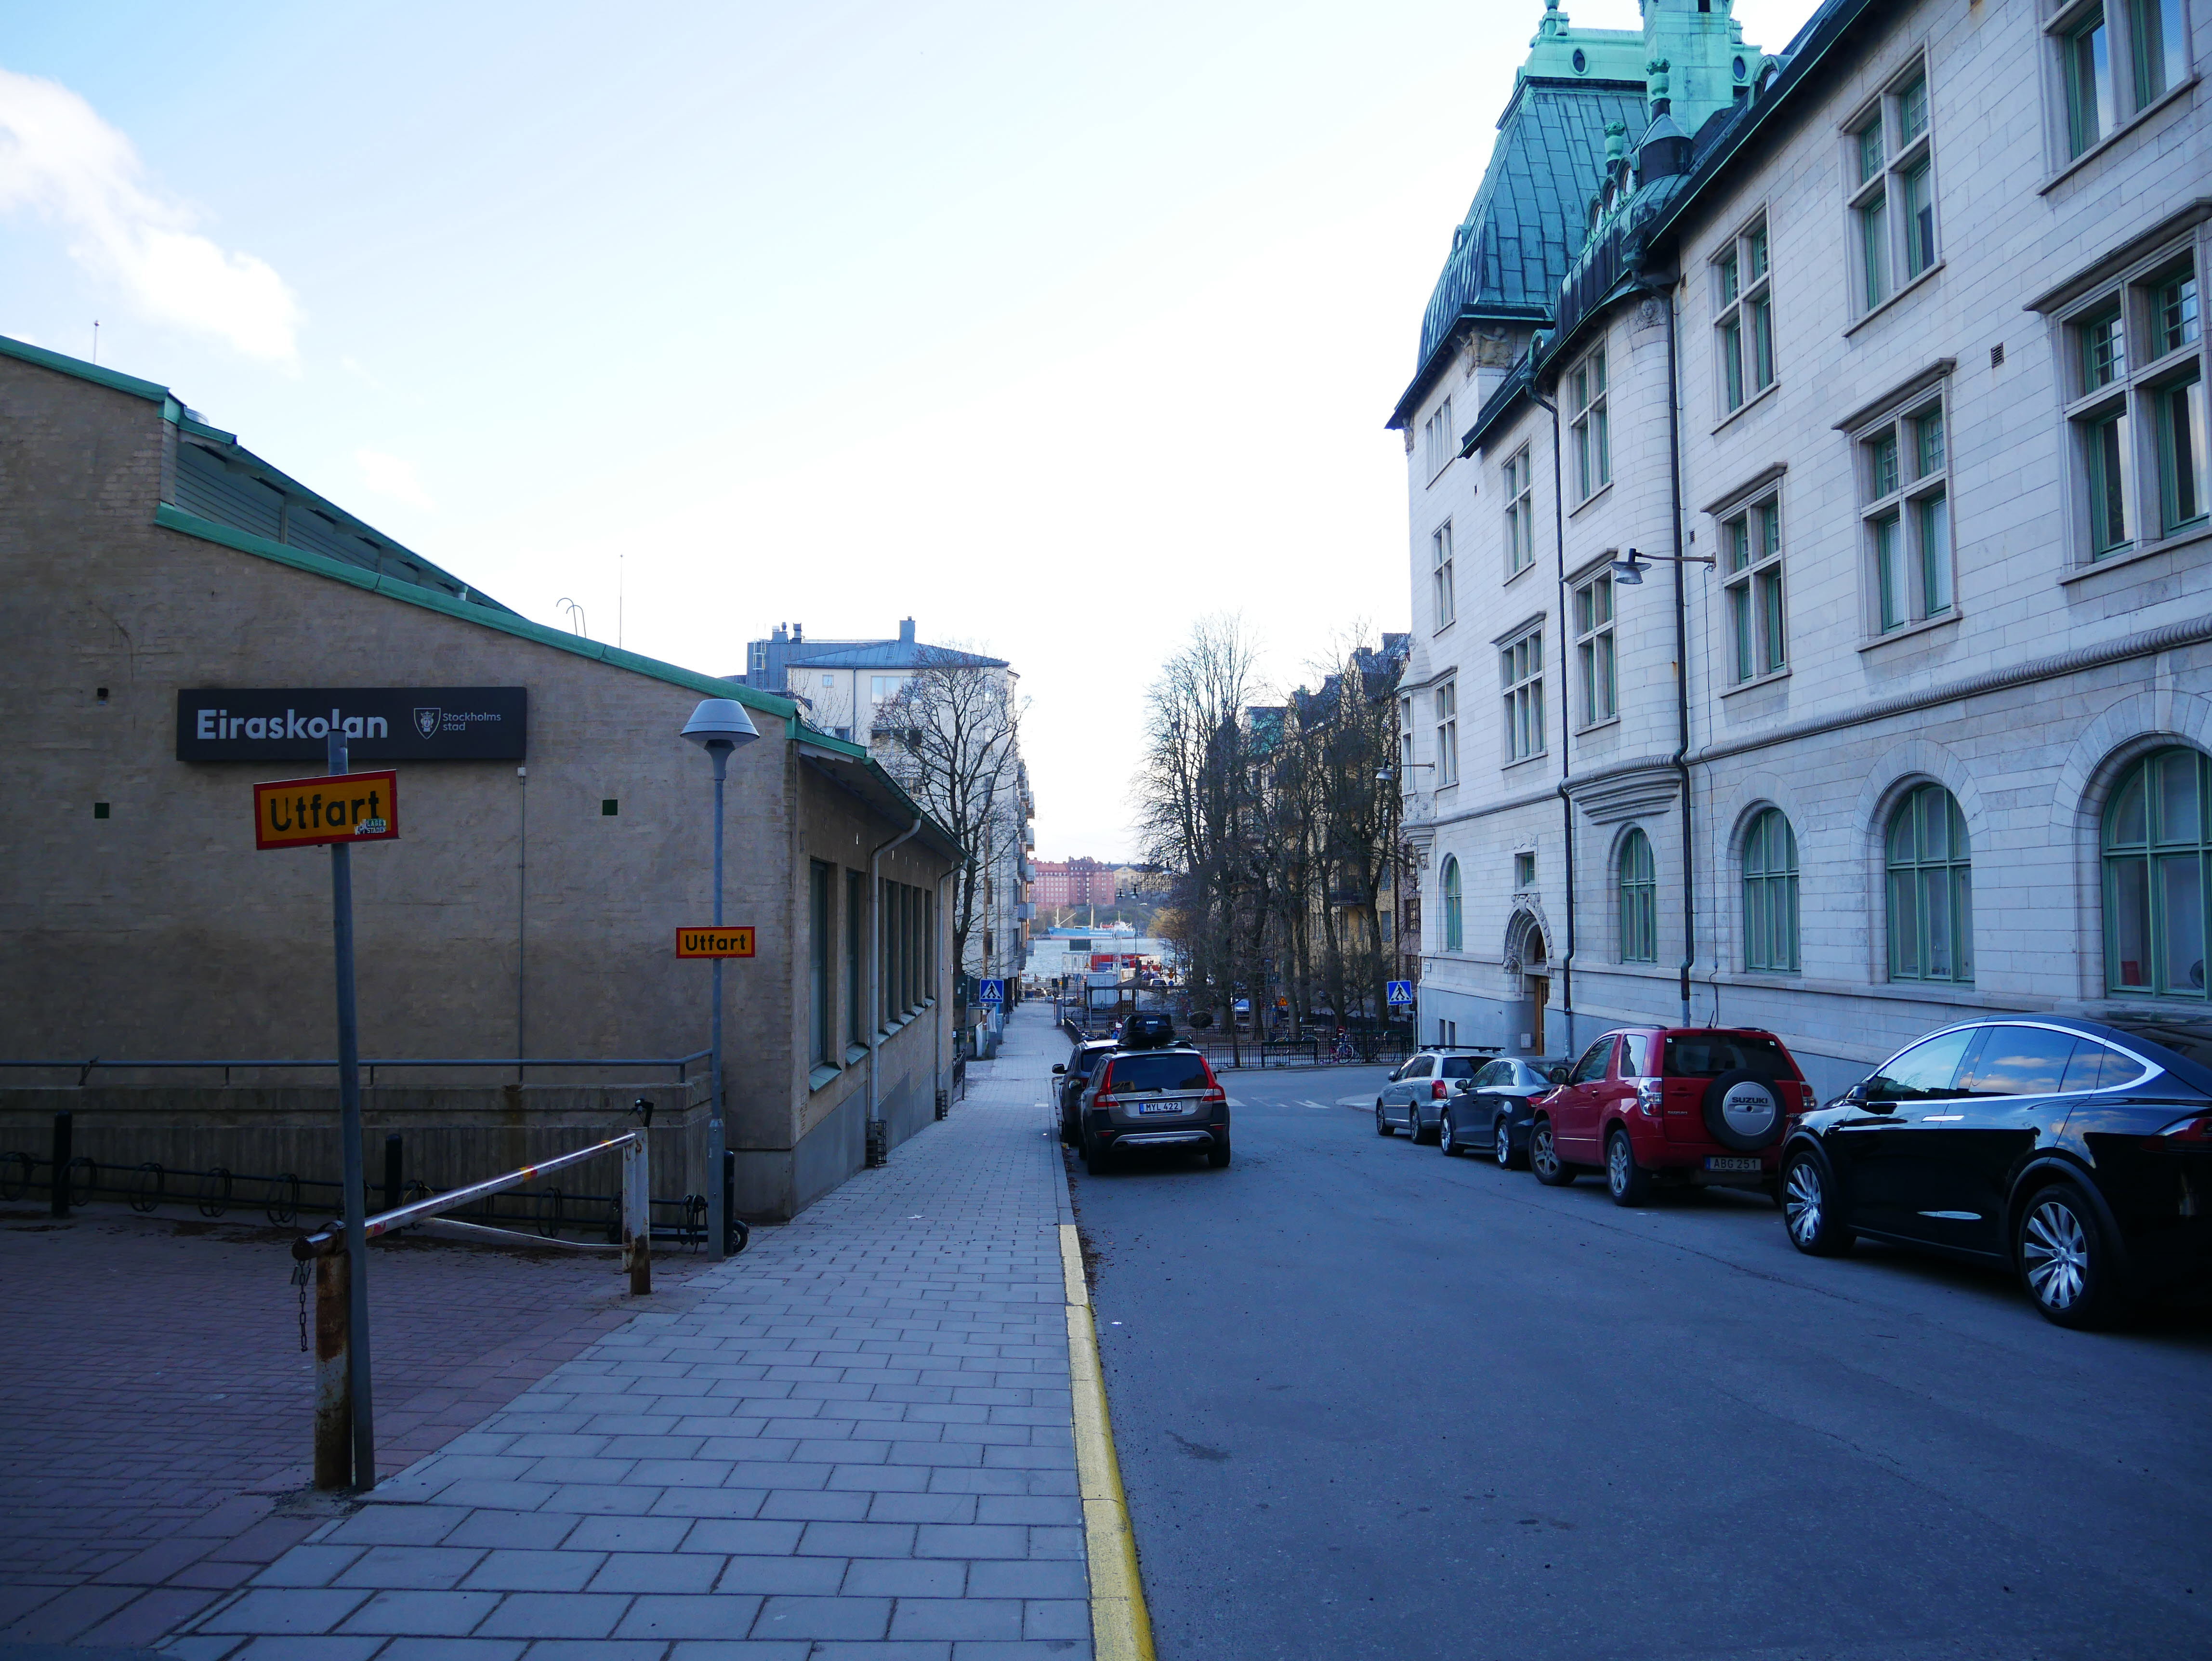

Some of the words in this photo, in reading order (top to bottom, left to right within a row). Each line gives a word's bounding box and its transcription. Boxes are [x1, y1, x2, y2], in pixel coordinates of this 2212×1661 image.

[442, 712, 501, 721] Stockholms
[197, 709, 388, 739] Eiraskolan
[443, 722, 466, 731] stad
[270, 791, 379, 831] Utfart
[685, 934, 746, 951] Utfart
[1714, 1159, 1733, 1168] ABG
[1737, 1160, 1756, 1169] 251
